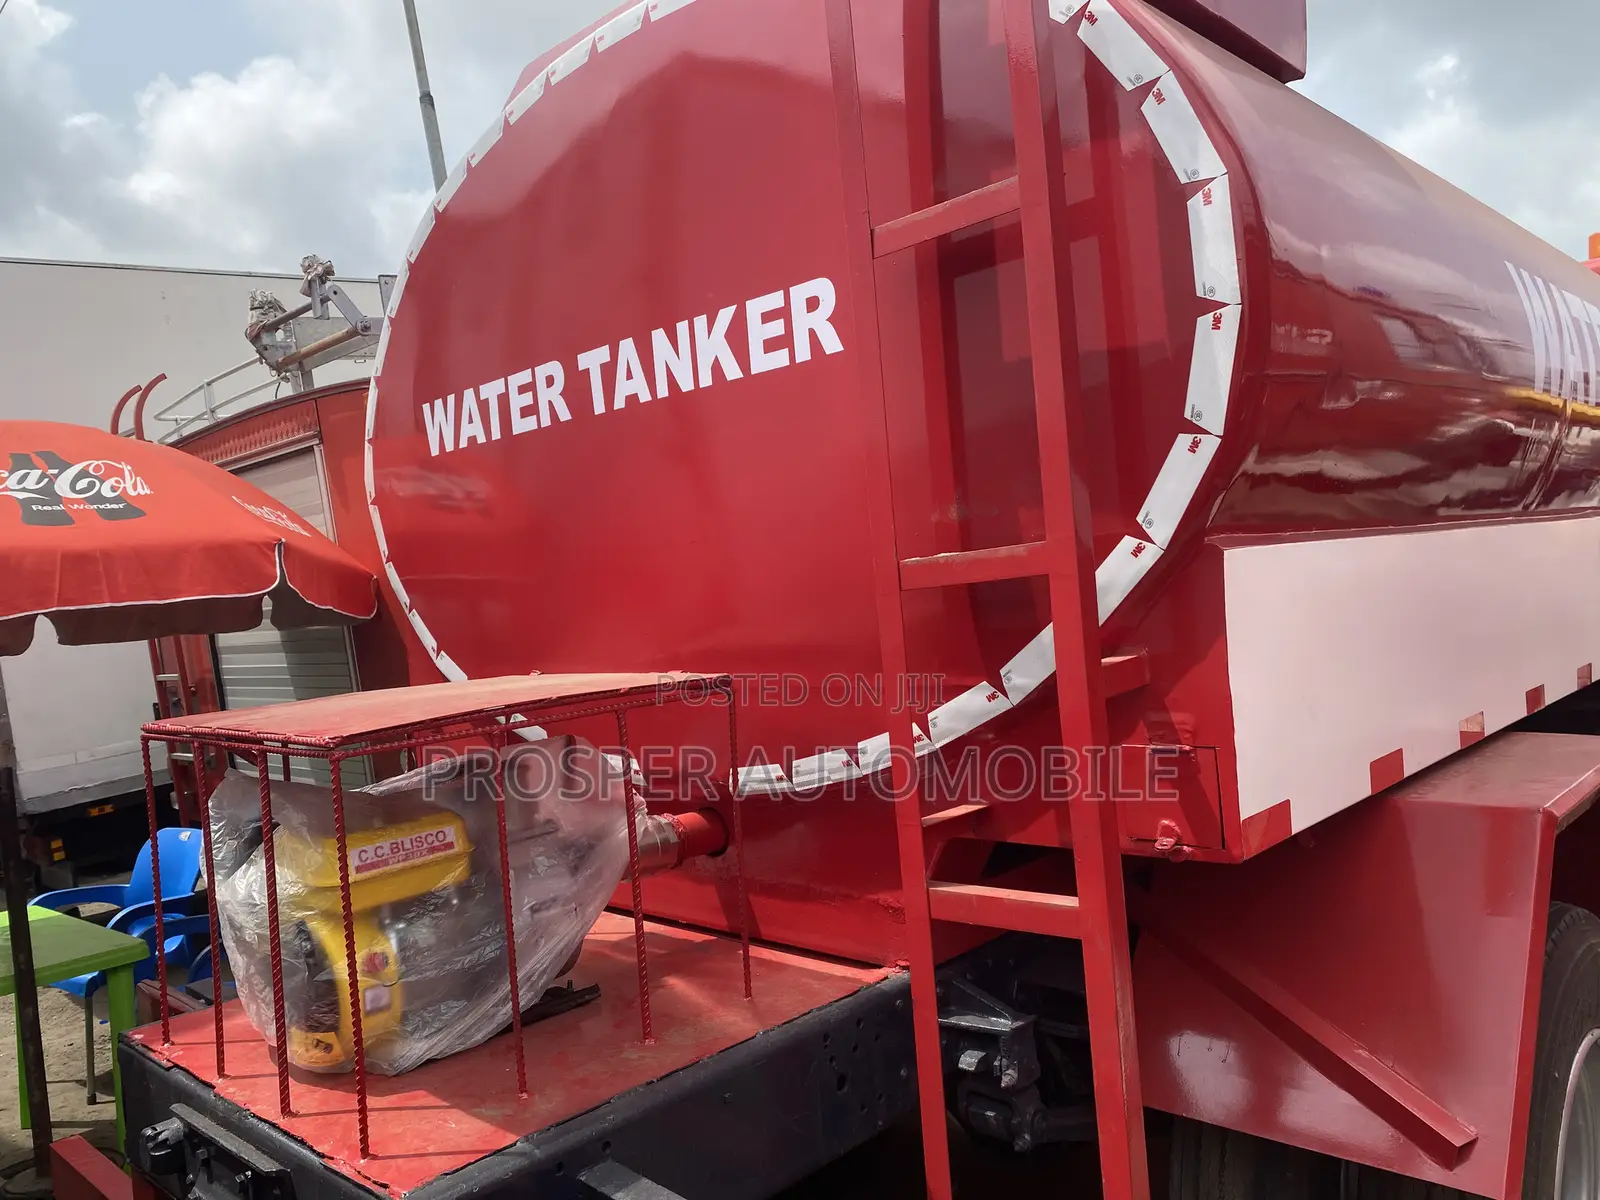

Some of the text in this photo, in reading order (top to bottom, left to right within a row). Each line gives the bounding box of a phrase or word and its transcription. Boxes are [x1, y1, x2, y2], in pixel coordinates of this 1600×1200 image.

[1084, 10, 1099, 27] 3M
[1151, 87, 1166, 106] 3M
[1201, 187, 1213, 207] 3M
[1211, 312, 1222, 330] 3M
[422, 277, 844, 457] WATER TANKER
[1187, 435, 1202, 454] 3M
[68, 502, 128, 511] Wonder
[1130, 541, 1146, 558] 3M
[986, 690, 1000, 703] 3M
[358, 830, 446, 861] C.C.BLISCO
